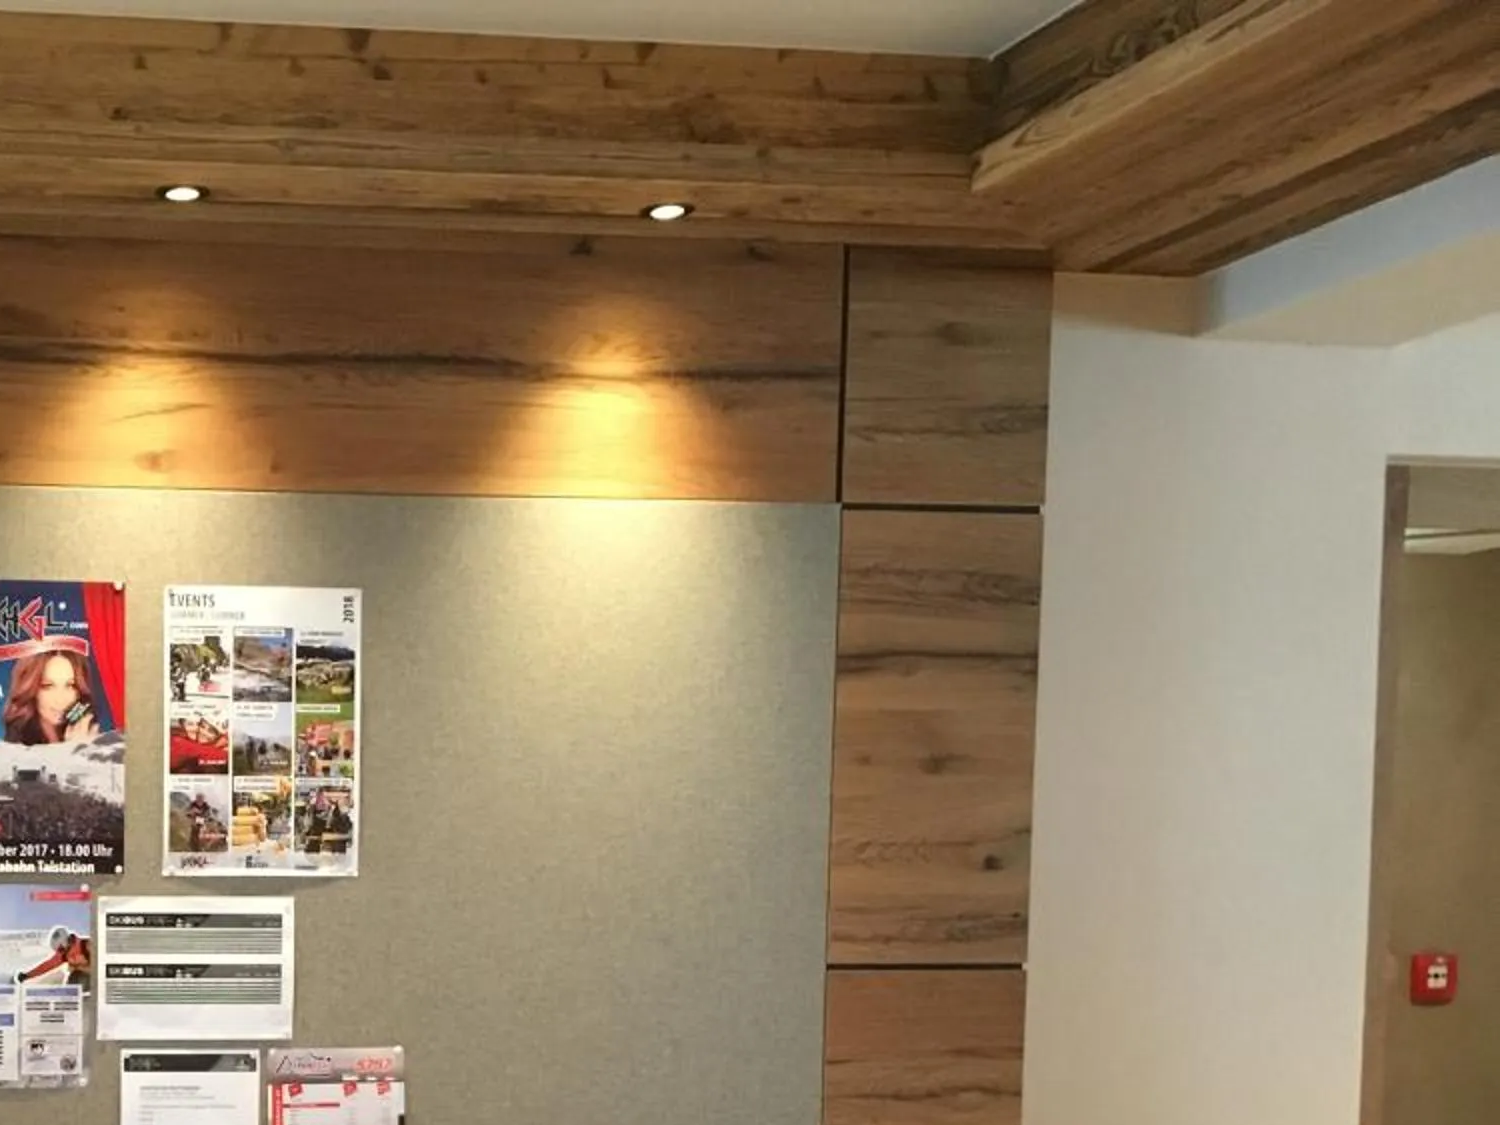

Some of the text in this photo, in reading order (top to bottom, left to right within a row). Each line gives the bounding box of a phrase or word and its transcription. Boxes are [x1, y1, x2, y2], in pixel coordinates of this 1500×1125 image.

[19, 843, 48, 857] 2017
[58, 844, 90, 857] 18.00
[92, 845, 113, 857] Uhr
[37, 859, 95, 873] Talstation
